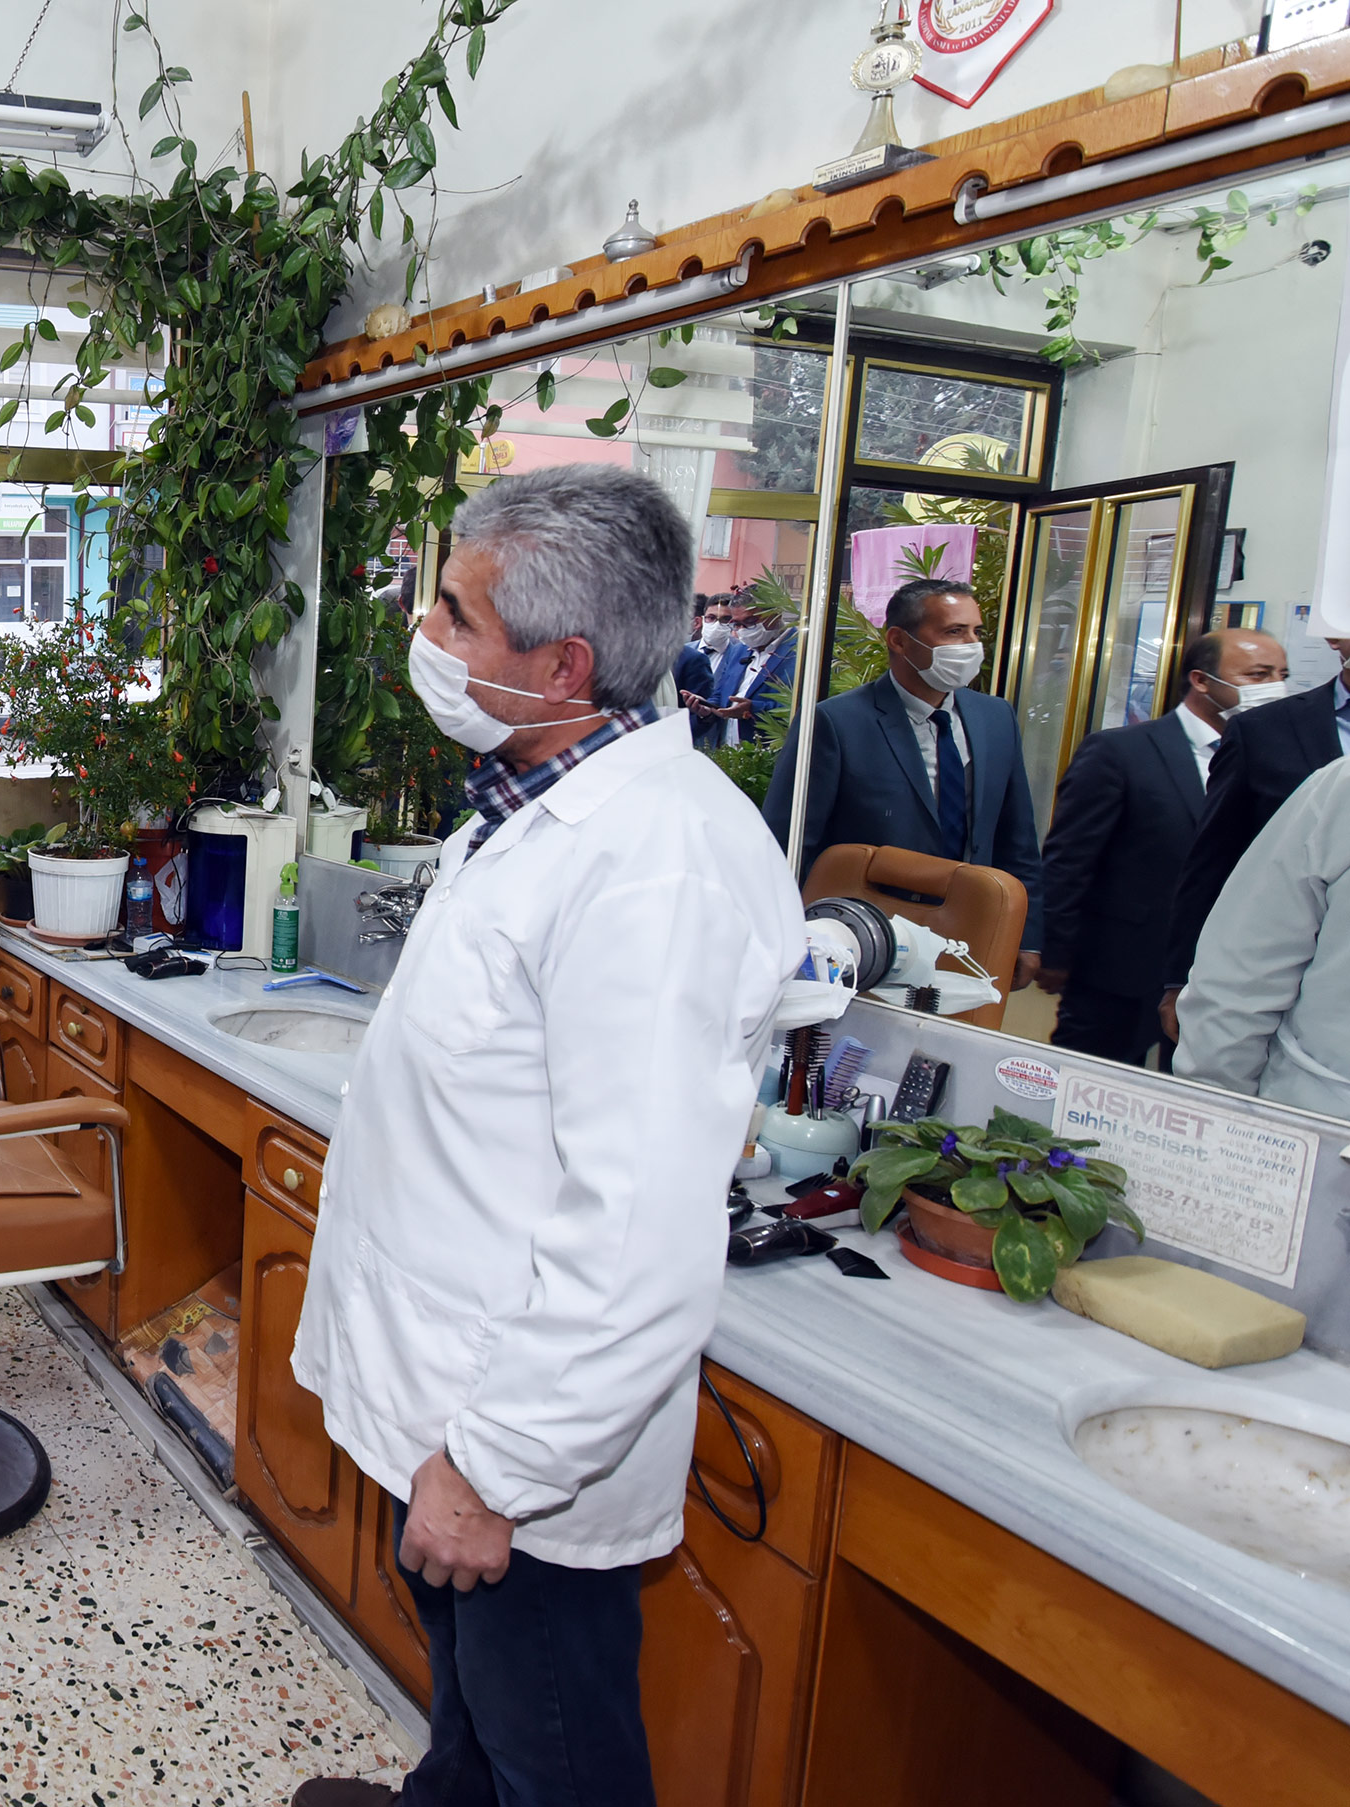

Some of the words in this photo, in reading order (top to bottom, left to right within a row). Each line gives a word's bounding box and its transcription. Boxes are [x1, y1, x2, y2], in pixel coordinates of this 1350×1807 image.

[959, 16, 982, 34] 2011
[1071, 1080, 1215, 1144] KISMET
[1065, 1105, 1118, 1136] sıhhi
[1120, 1122, 1210, 1164] tesisat
[1256, 1132, 1296, 1152] PEKER
[1218, 1146, 1253, 1164] Yunus
[1256, 1157, 1296, 1176] PEKER
[1130, 1178, 1175, 1201] 0332
[1179, 1193, 1215, 1215] 712
[1248, 1216, 1275, 1235] 82
